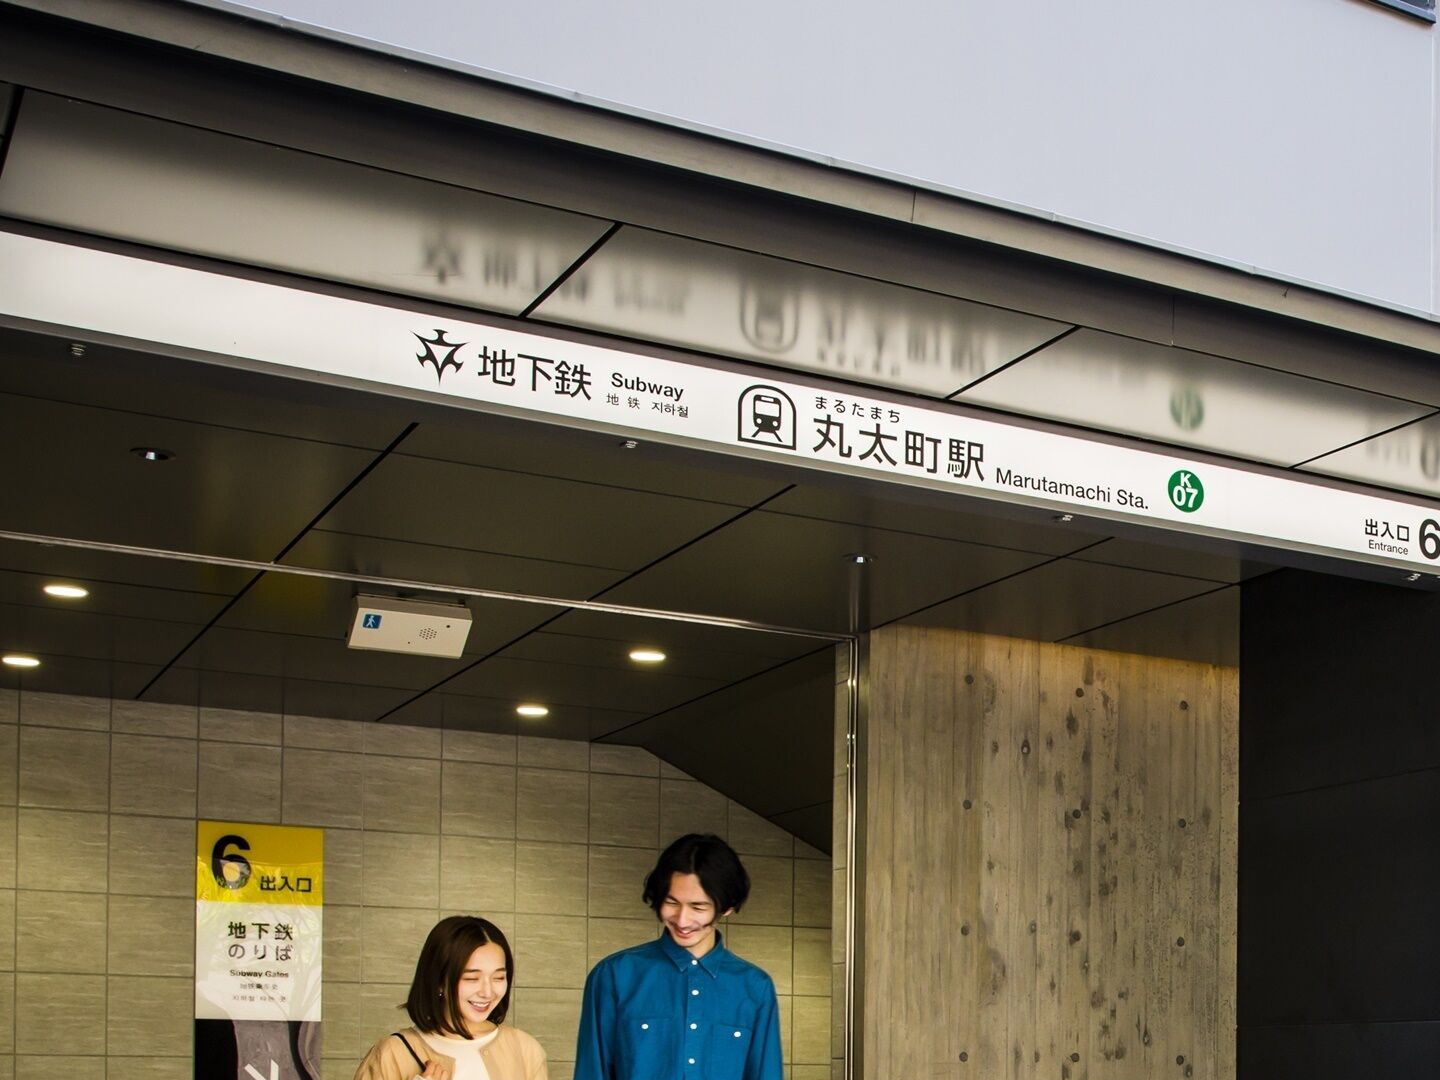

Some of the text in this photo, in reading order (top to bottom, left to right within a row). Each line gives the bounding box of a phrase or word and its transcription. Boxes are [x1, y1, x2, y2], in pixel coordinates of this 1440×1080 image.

[477, 345, 592, 401] 地下鉄
[611, 372, 684, 402] Subway
[652, 401, 689, 418] 지하철
[815, 396, 900, 424] まるたまち
[812, 414, 985, 482] 丸太町駅
[996, 467, 1149, 509] Marutamachi Sta.
[1179, 472, 1192, 489] K
[1172, 485, 1199, 509] 07
[1364, 518, 1409, 543] 出入口
[1368, 539, 1409, 556] Entrance
[212, 834, 312, 892] 6 出入口
[228, 921, 293, 941] 地下鉄
[228, 943, 293, 961] のりば
